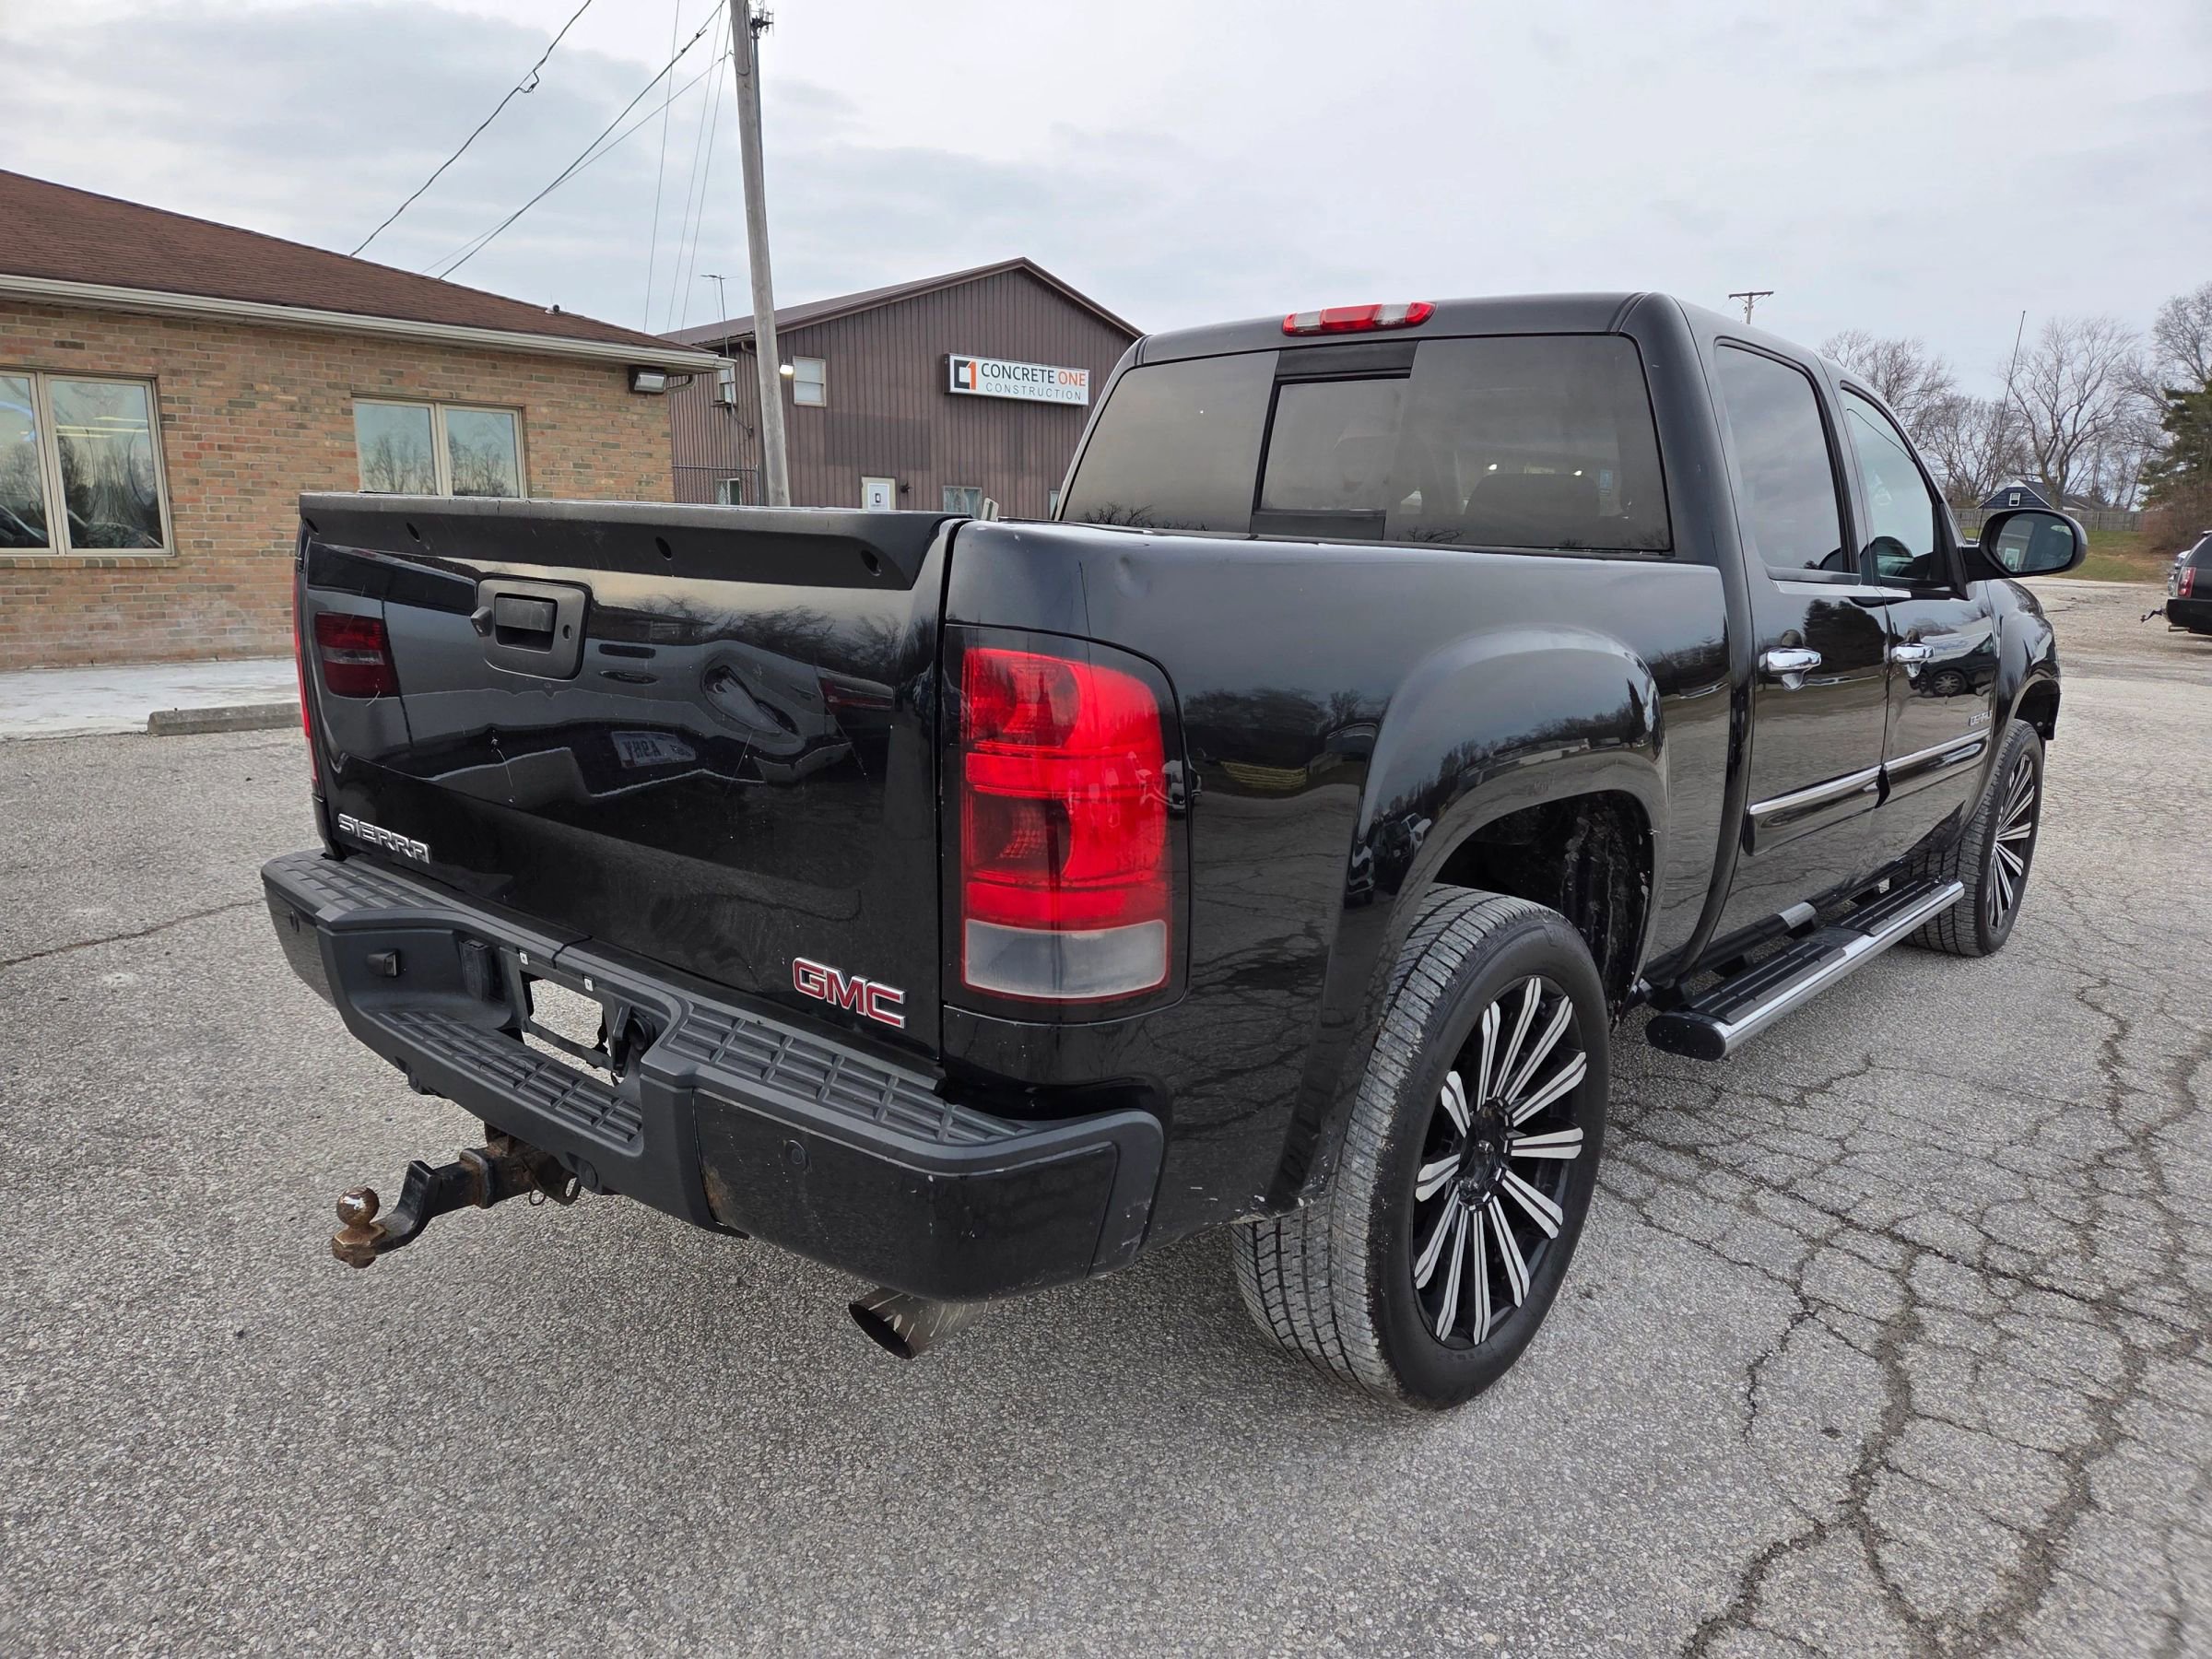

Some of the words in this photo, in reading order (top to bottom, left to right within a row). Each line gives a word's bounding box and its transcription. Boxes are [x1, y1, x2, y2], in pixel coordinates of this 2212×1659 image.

[981, 362, 1055, 384] CONCRETE
[1058, 371, 1087, 387] ONE
[985, 382, 1082, 401] CONSTRUCTION
[337, 813, 431, 865] SIERRA
[793, 957, 906, 1030] GMC
